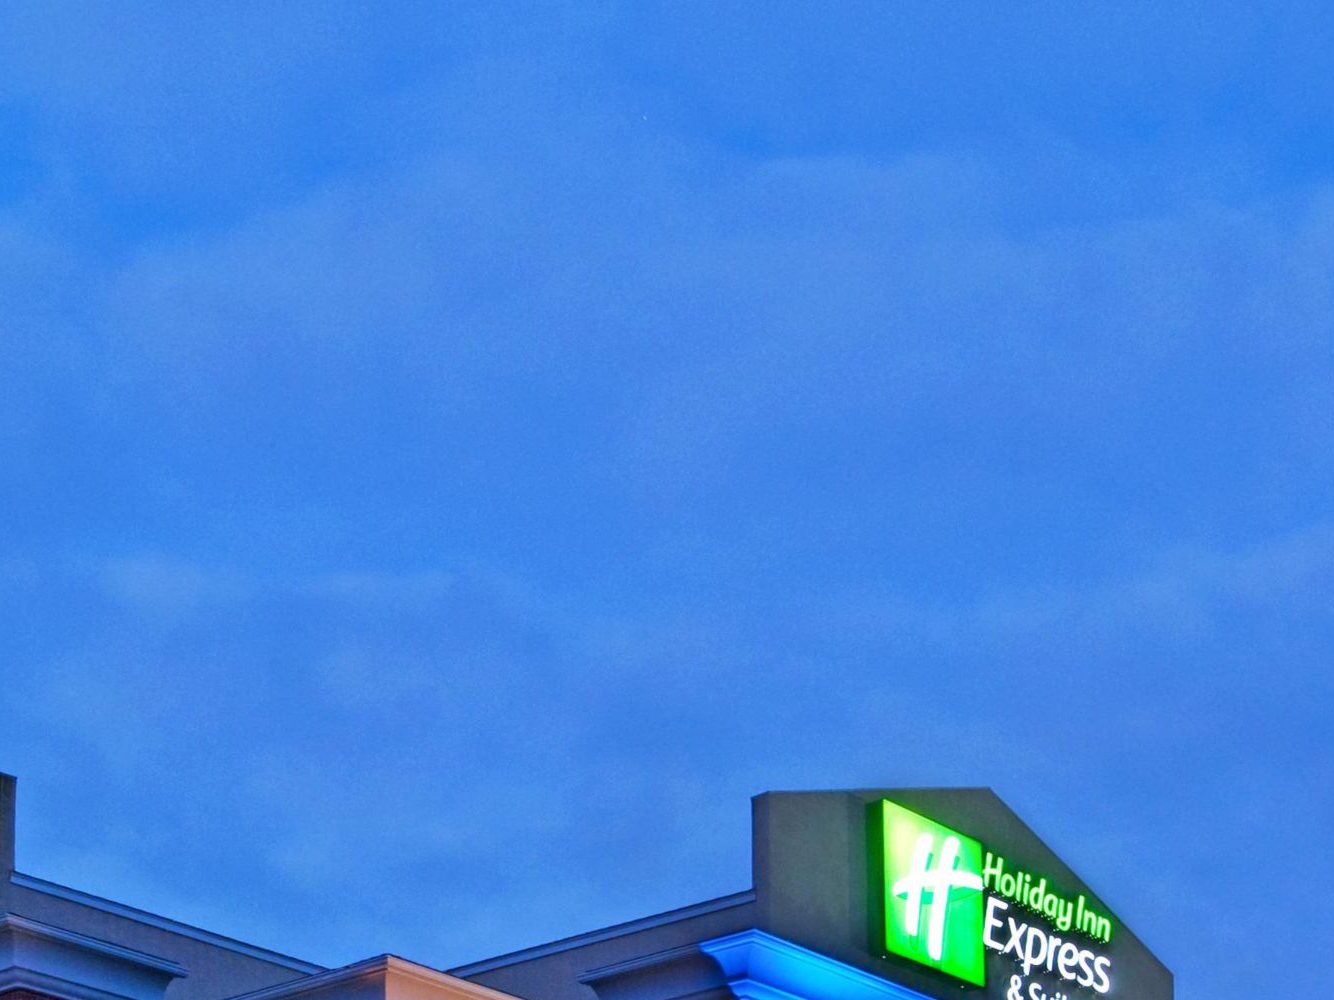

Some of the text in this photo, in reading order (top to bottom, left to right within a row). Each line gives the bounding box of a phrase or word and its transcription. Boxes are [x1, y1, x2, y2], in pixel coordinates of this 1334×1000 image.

[983, 851, 1111, 942] Holiday Inn
[982, 896, 1112, 994] Express
